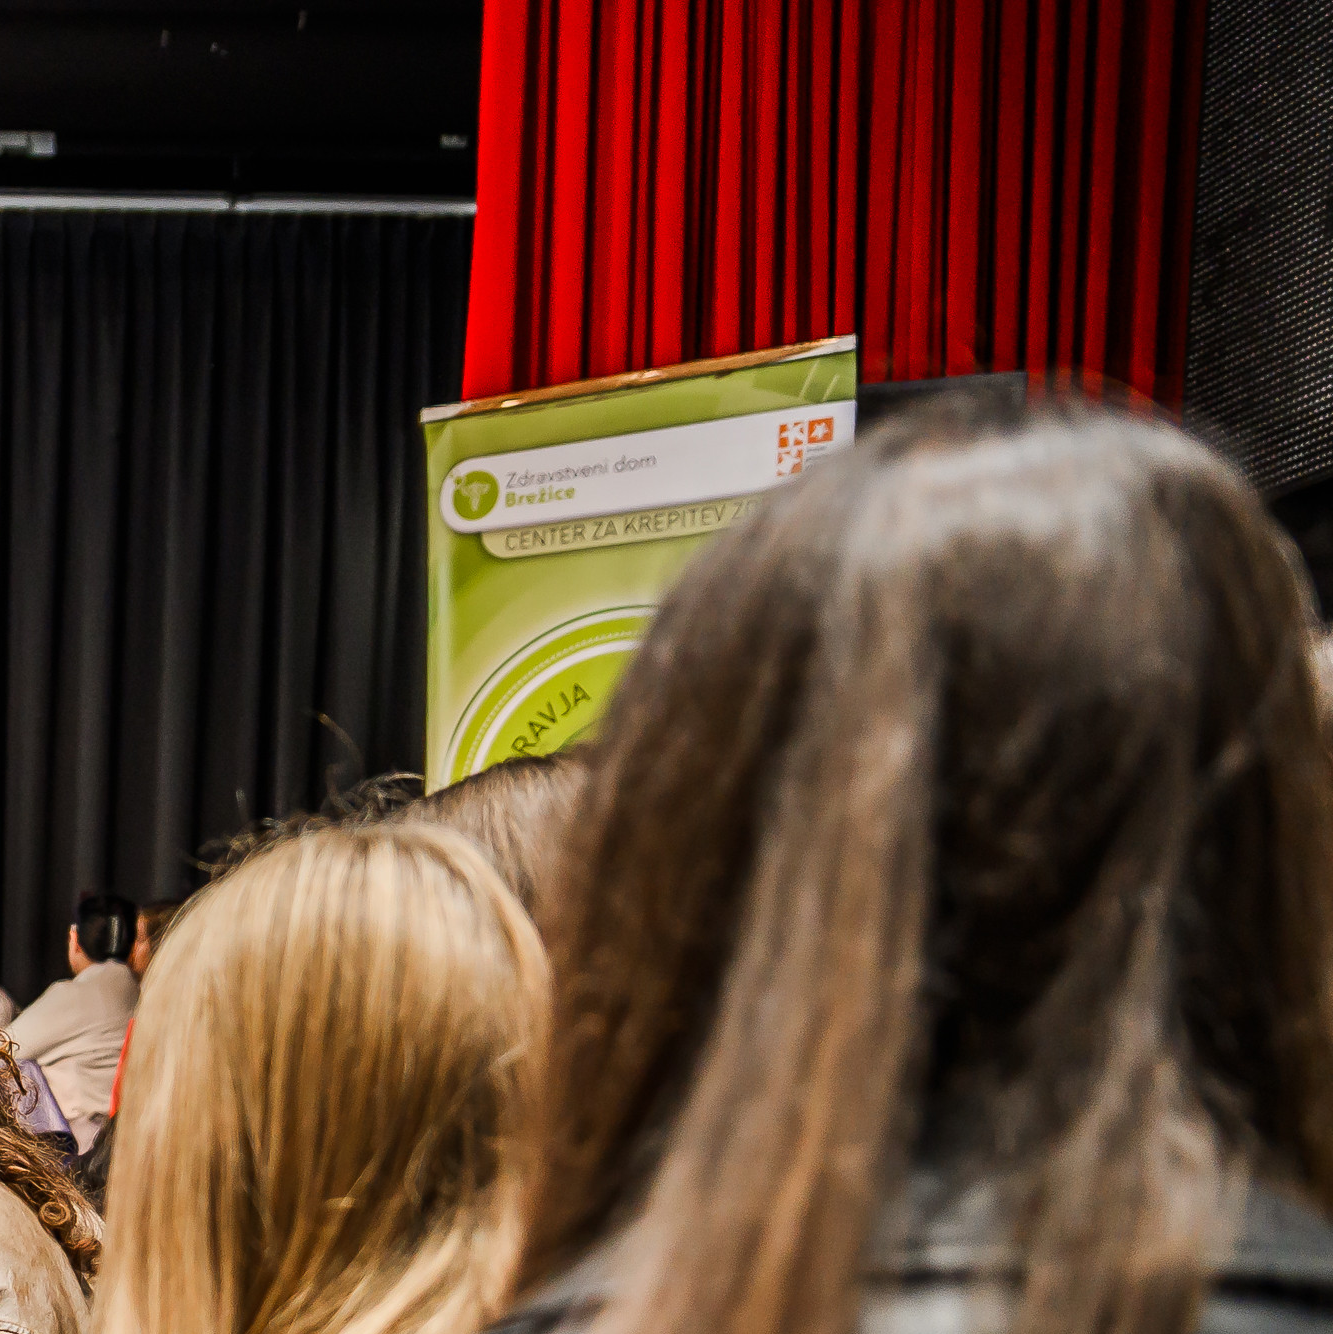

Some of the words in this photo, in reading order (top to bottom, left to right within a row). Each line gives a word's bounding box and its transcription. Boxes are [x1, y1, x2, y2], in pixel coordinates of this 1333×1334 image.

[506, 457, 608, 489] Zdravstveni
[614, 454, 658, 474] dom
[504, 486, 576, 508] Brežice
[504, 522, 587, 551] CENTER
[592, 518, 618, 541] ZA
[624, 503, 727, 535] KREPITEV
